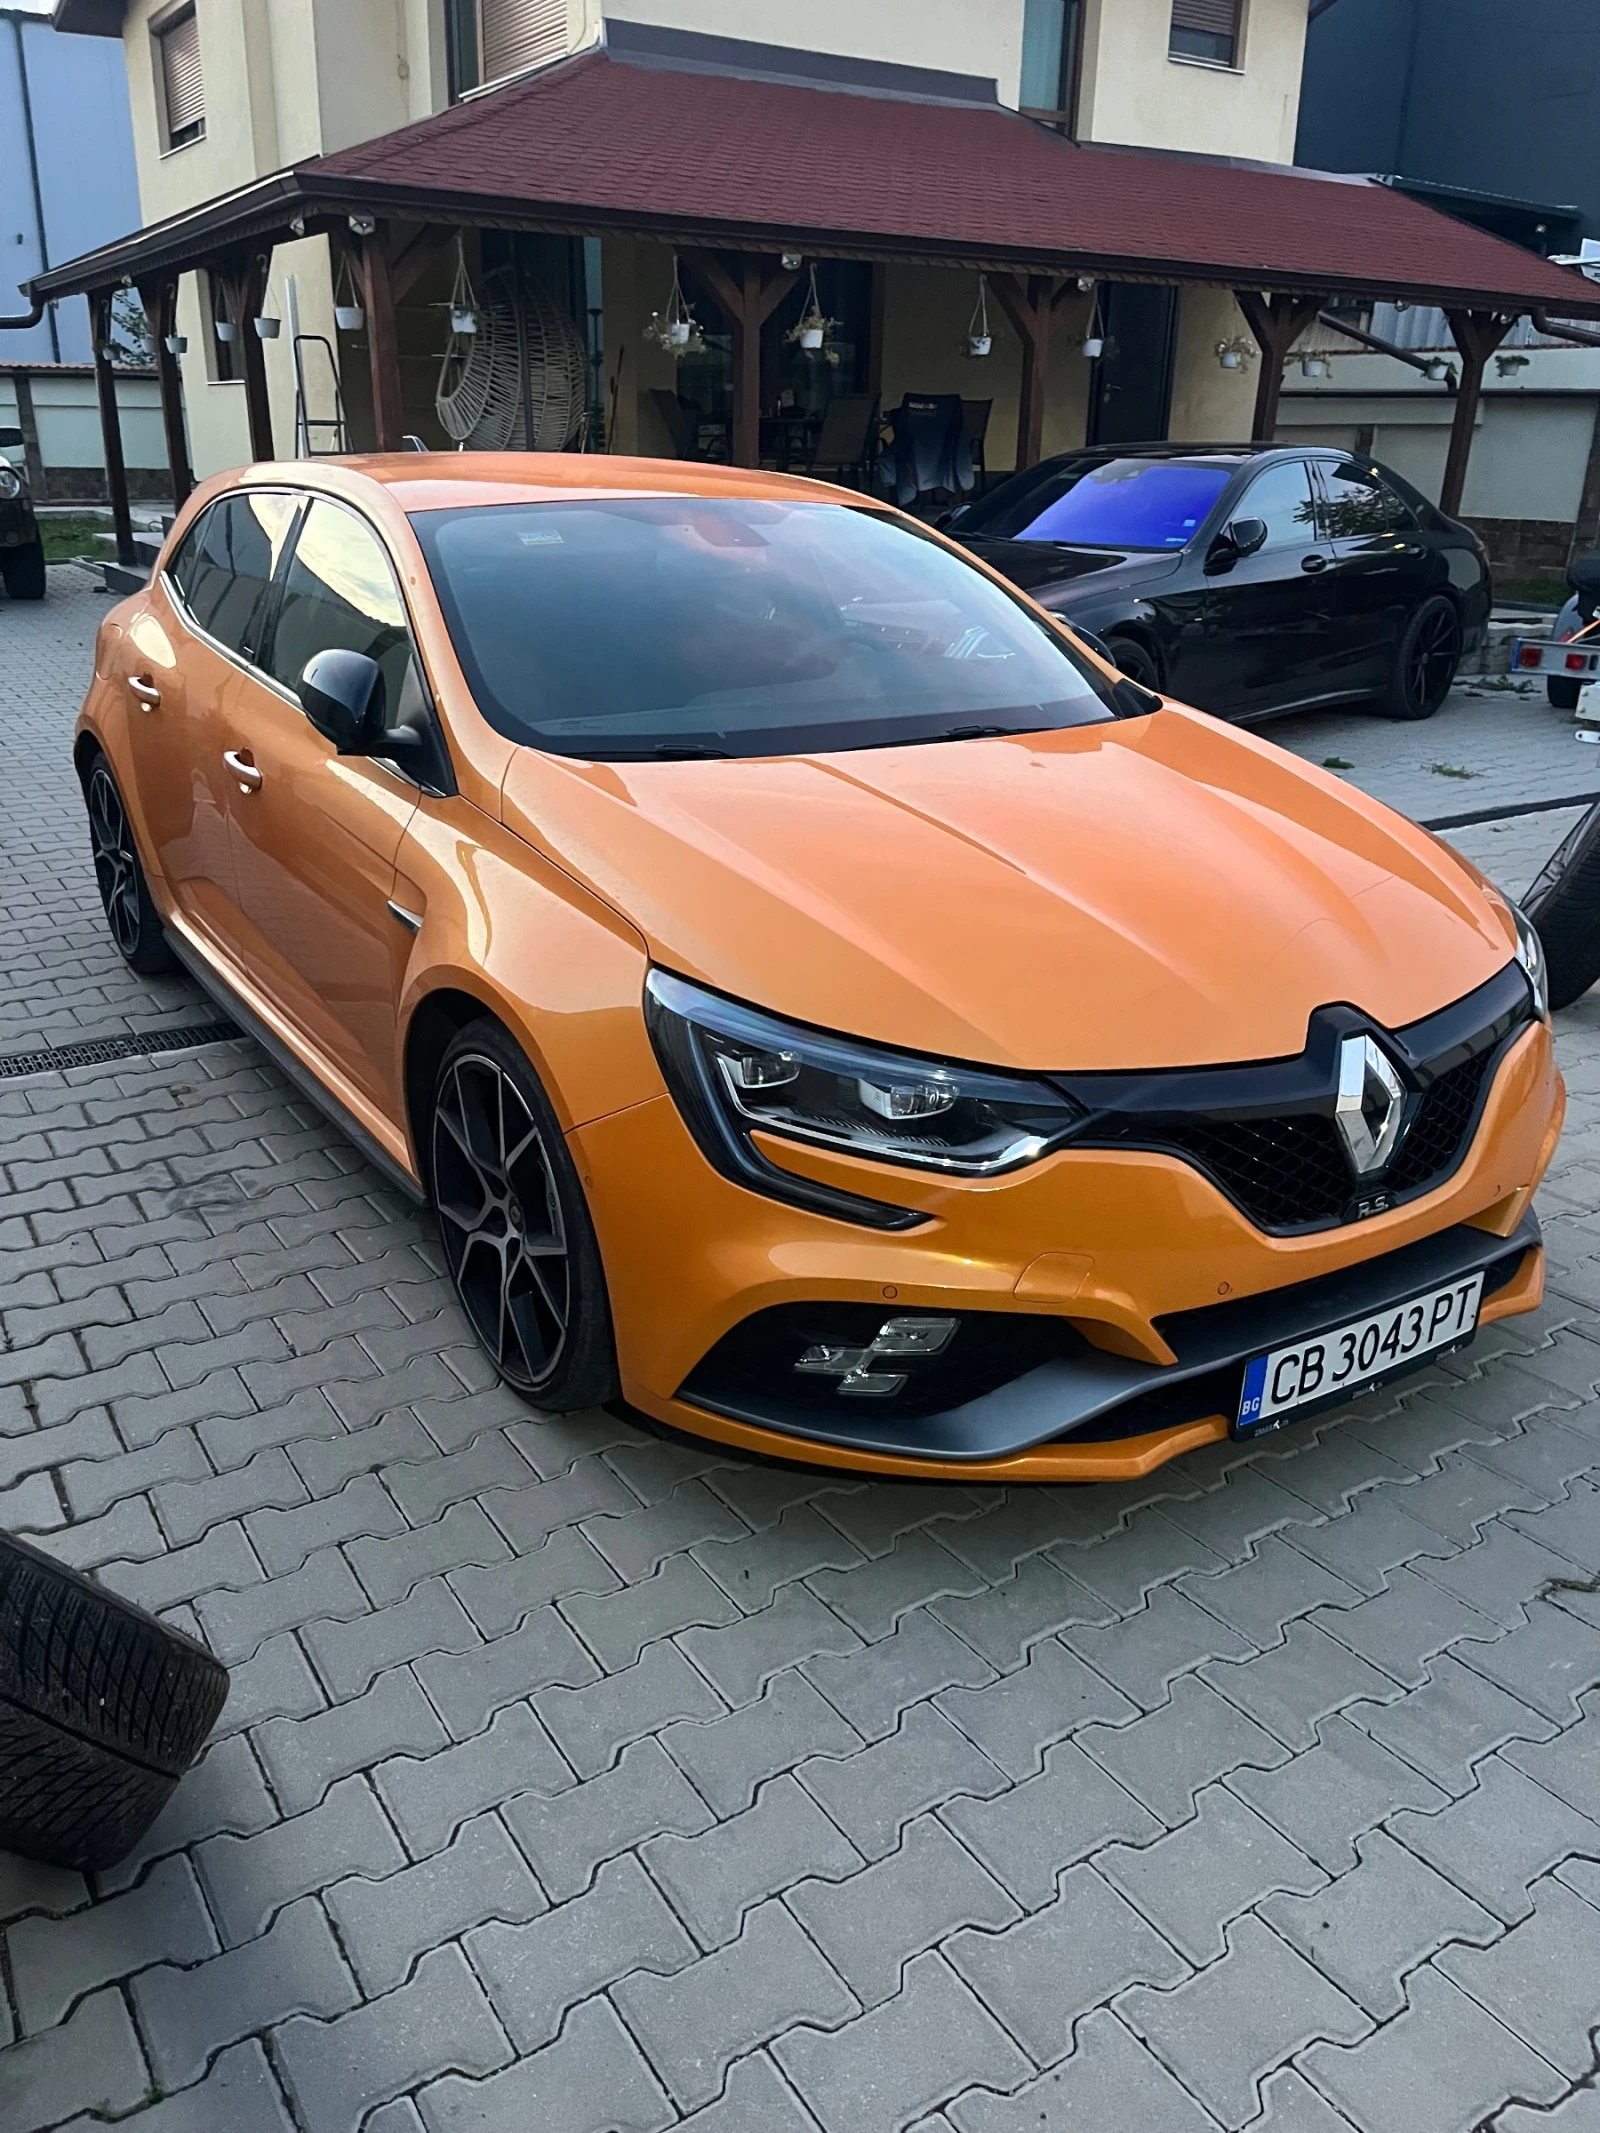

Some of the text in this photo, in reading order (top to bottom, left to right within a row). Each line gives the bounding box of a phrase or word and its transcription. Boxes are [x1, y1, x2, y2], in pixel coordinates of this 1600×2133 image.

[1271, 1280, 1478, 1405] CB 3043 PT
[1241, 1396, 1260, 1416] BG
